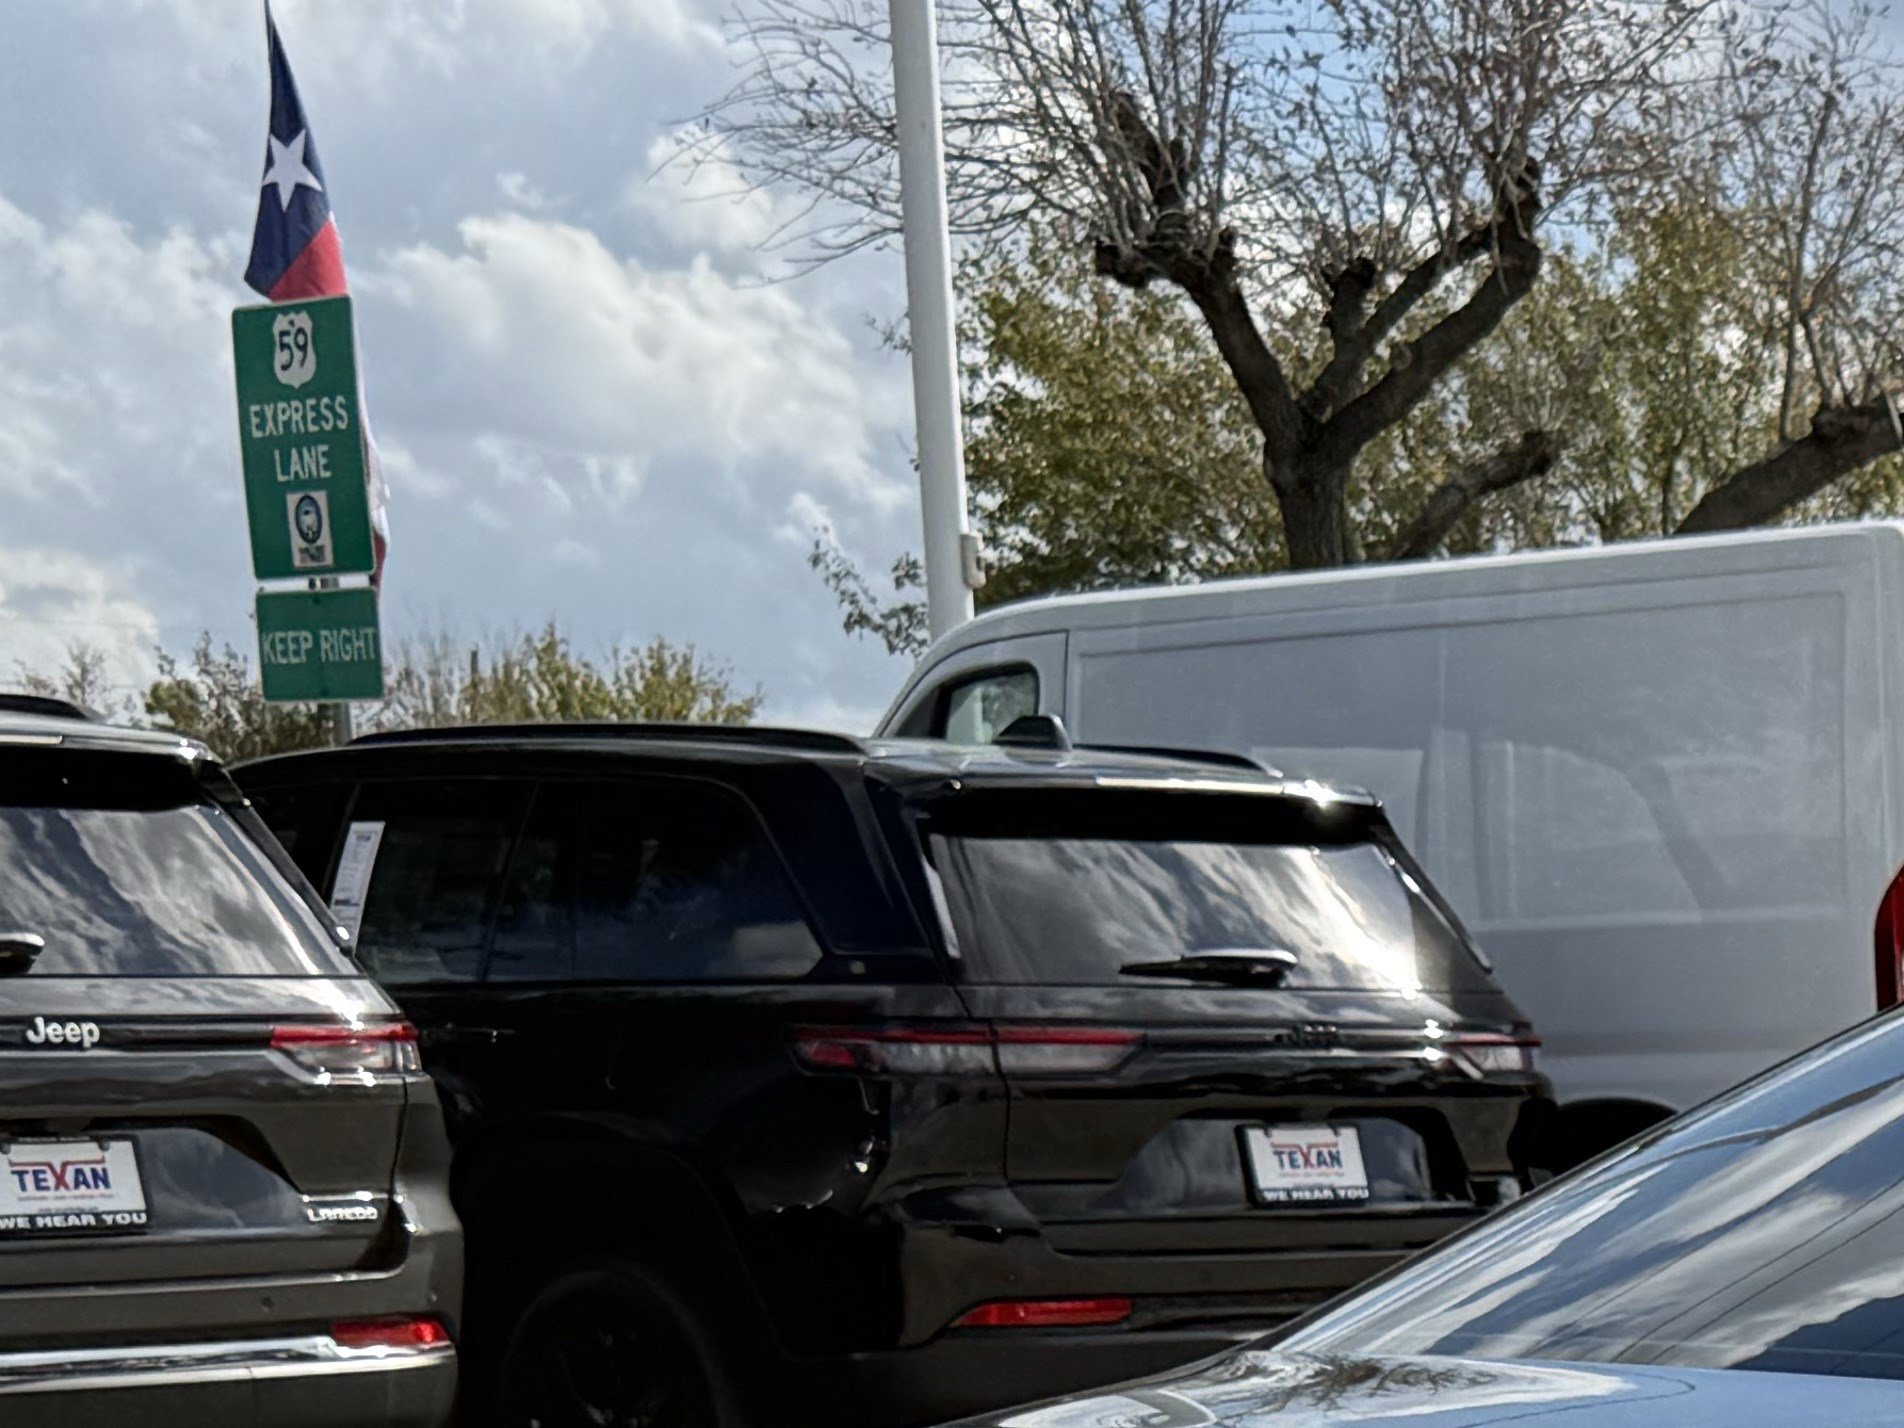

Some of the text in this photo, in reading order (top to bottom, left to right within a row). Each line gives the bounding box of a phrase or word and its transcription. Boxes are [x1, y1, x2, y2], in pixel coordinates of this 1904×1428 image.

[278, 326, 309, 371] 59
[249, 395, 350, 438] EXPRESS
[274, 443, 332, 483] LANE
[262, 626, 376, 665] KEEP RIGHT
[26, 1016, 101, 1049] Jeep
[1272, 1143, 1344, 1169] TEXAN
[10, 1159, 112, 1192] TEXAN
[0, 1212, 147, 1230] WE HEAR YOU
